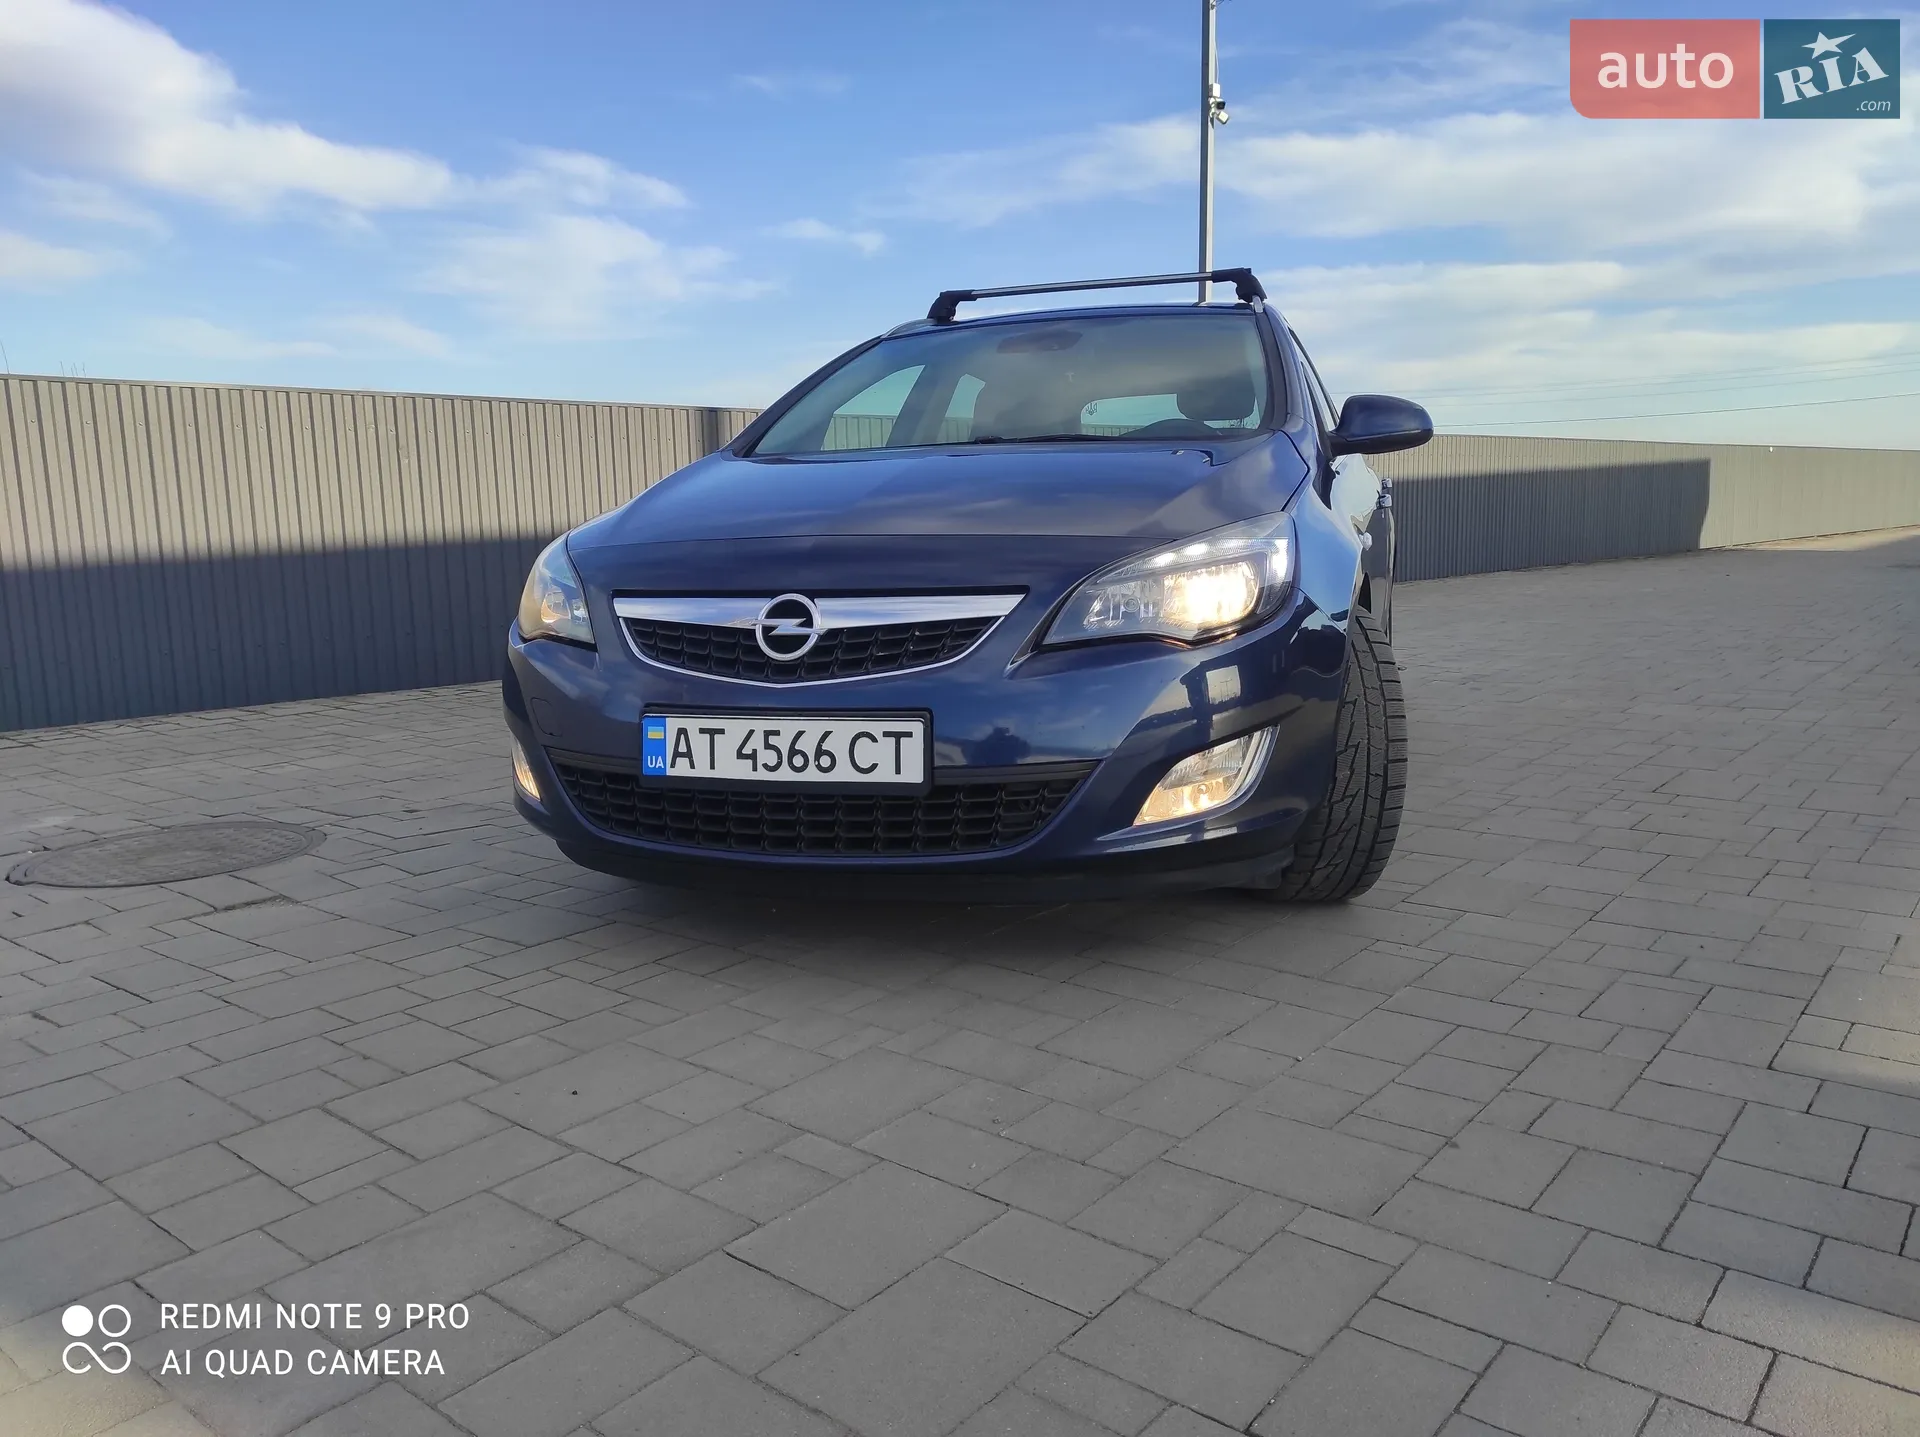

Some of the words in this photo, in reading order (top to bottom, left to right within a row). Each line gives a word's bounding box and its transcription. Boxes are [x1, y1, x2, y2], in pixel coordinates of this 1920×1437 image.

[647, 755, 665, 769] UA
[669, 727, 726, 770] AT
[736, 729, 837, 773] 4566
[849, 731, 914, 775] CT
